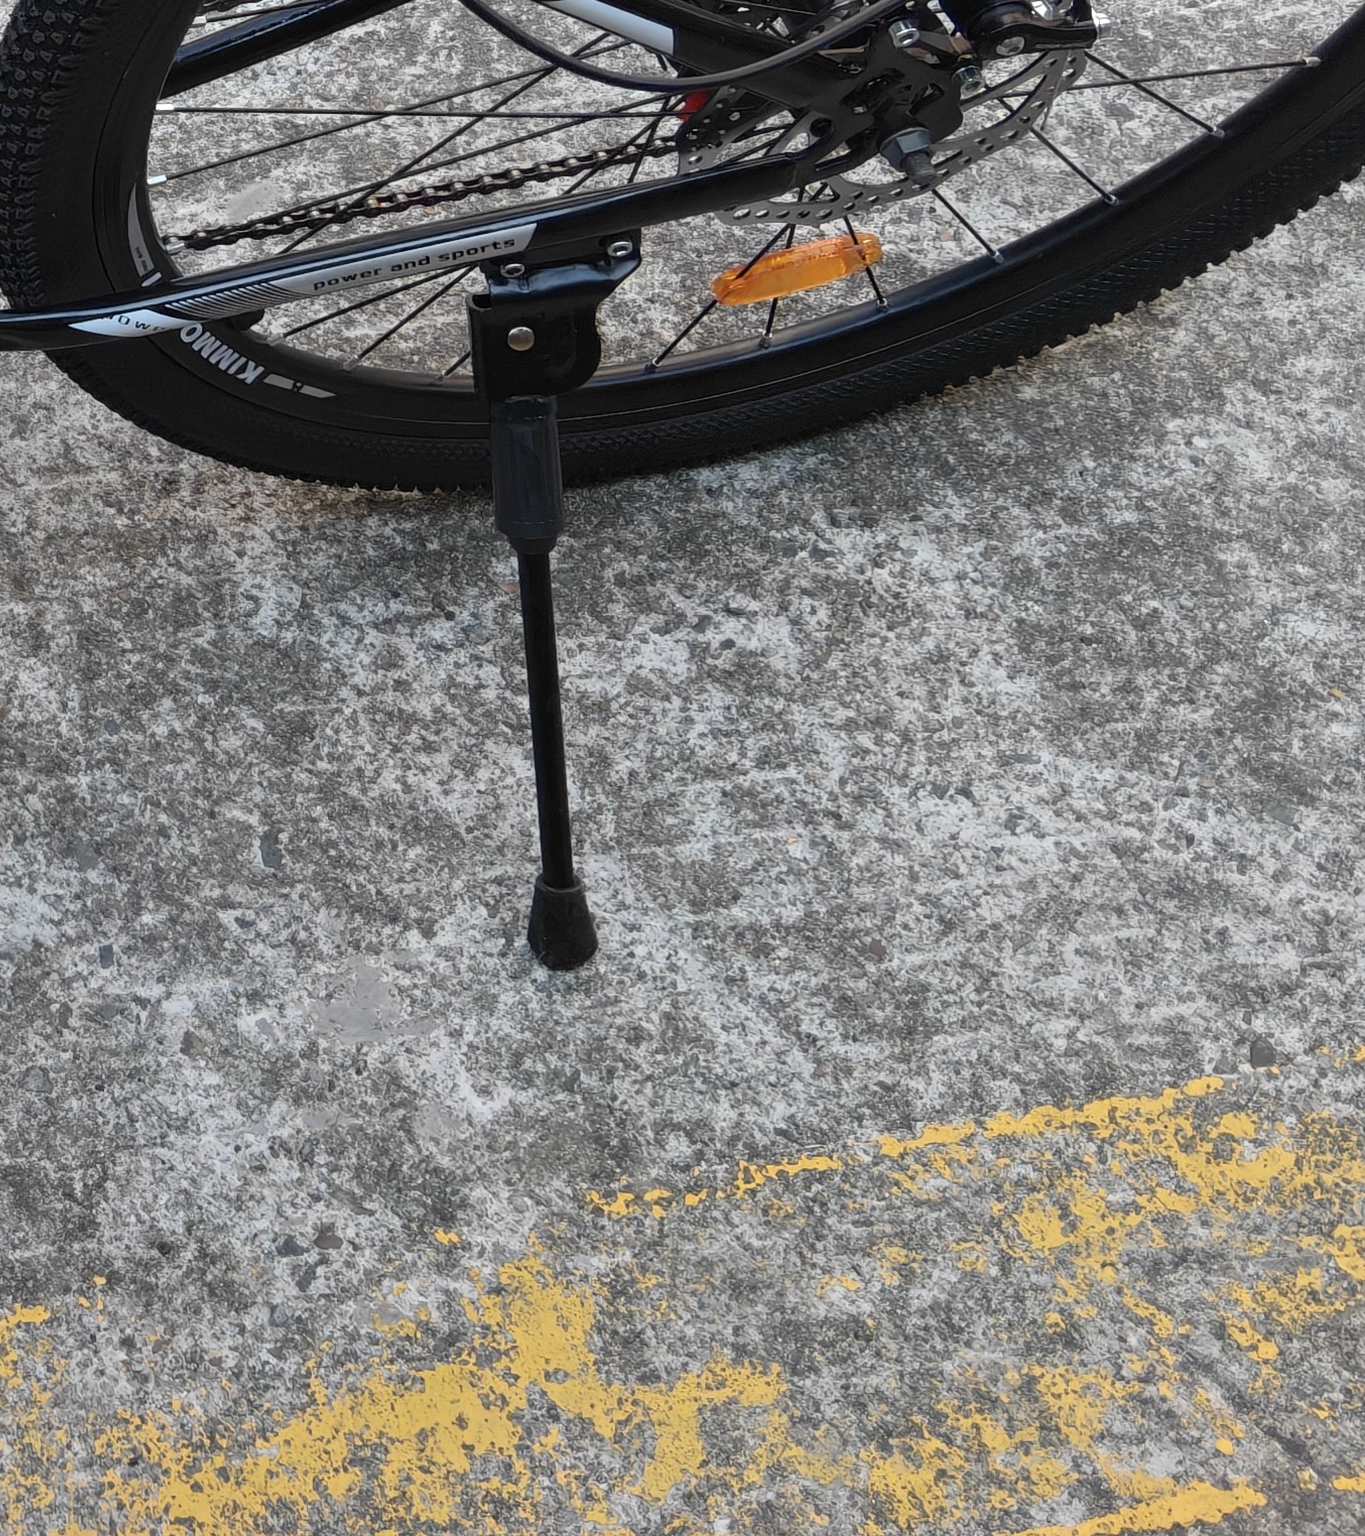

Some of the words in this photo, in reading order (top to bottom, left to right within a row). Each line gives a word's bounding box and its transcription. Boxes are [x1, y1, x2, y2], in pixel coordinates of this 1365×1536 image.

[313, 267, 382, 292] power
[390, 255, 431, 272] and
[437, 238, 516, 262] sports
